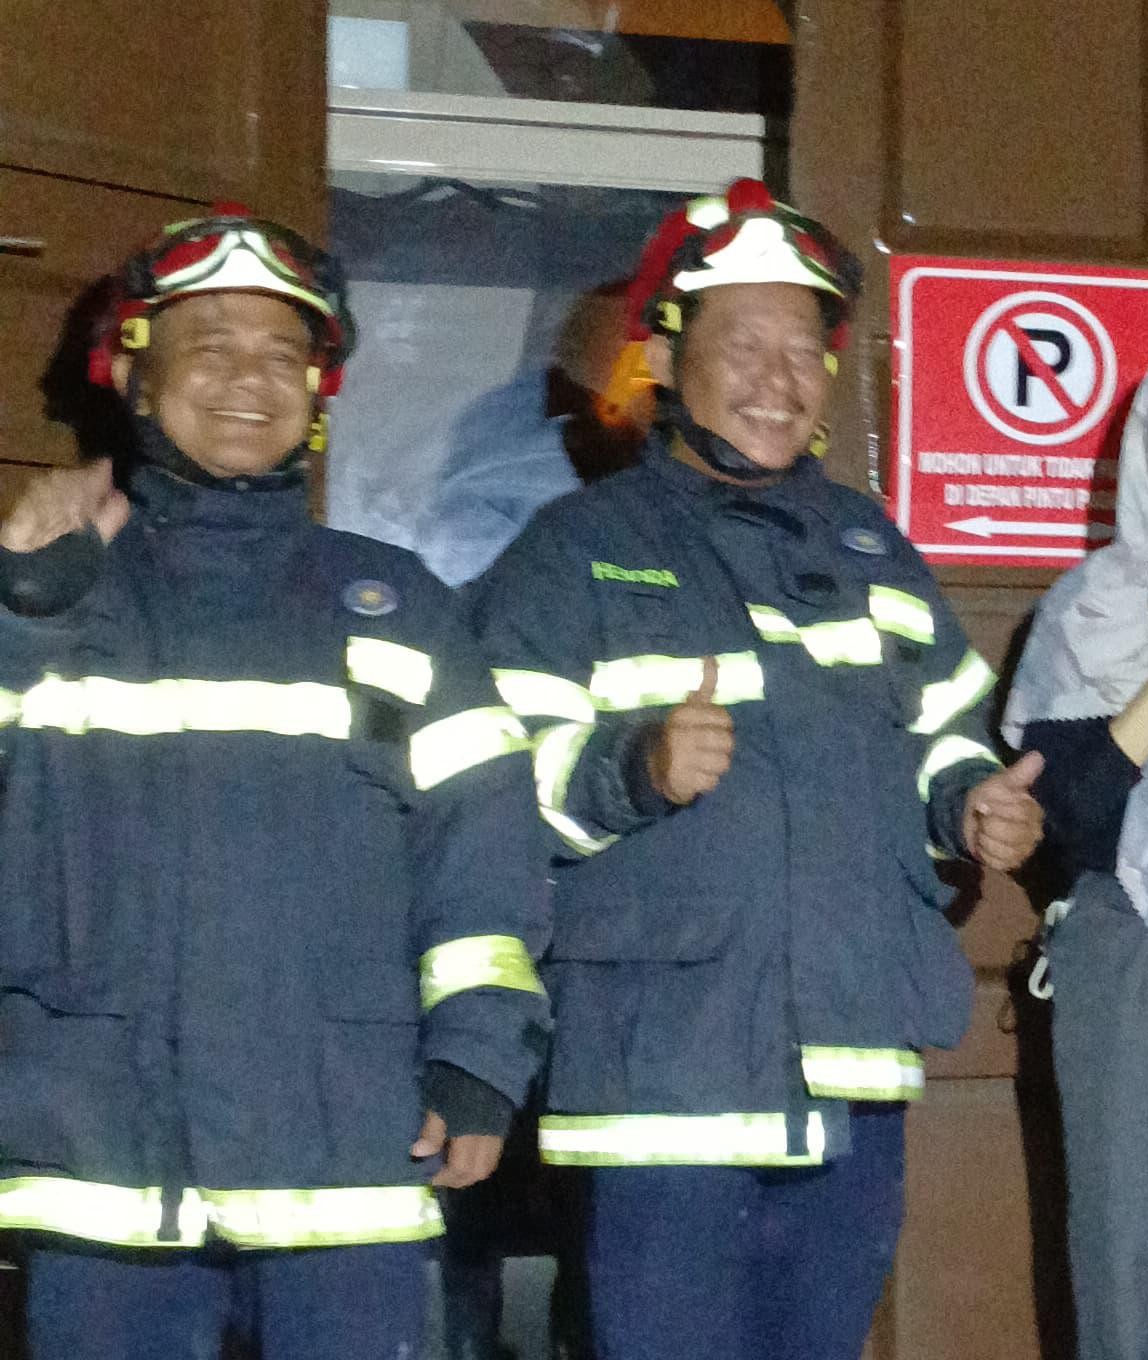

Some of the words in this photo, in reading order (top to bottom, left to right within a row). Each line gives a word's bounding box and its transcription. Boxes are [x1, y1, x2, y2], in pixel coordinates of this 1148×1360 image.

[1016, 328, 1071, 407] P
[918, 451, 981, 475] MOHON
[982, 454, 1044, 477] UNTUK
[944, 483, 964, 506] DI
[965, 484, 1021, 508] DEPAN
[1023, 486, 1075, 510] PINTU
